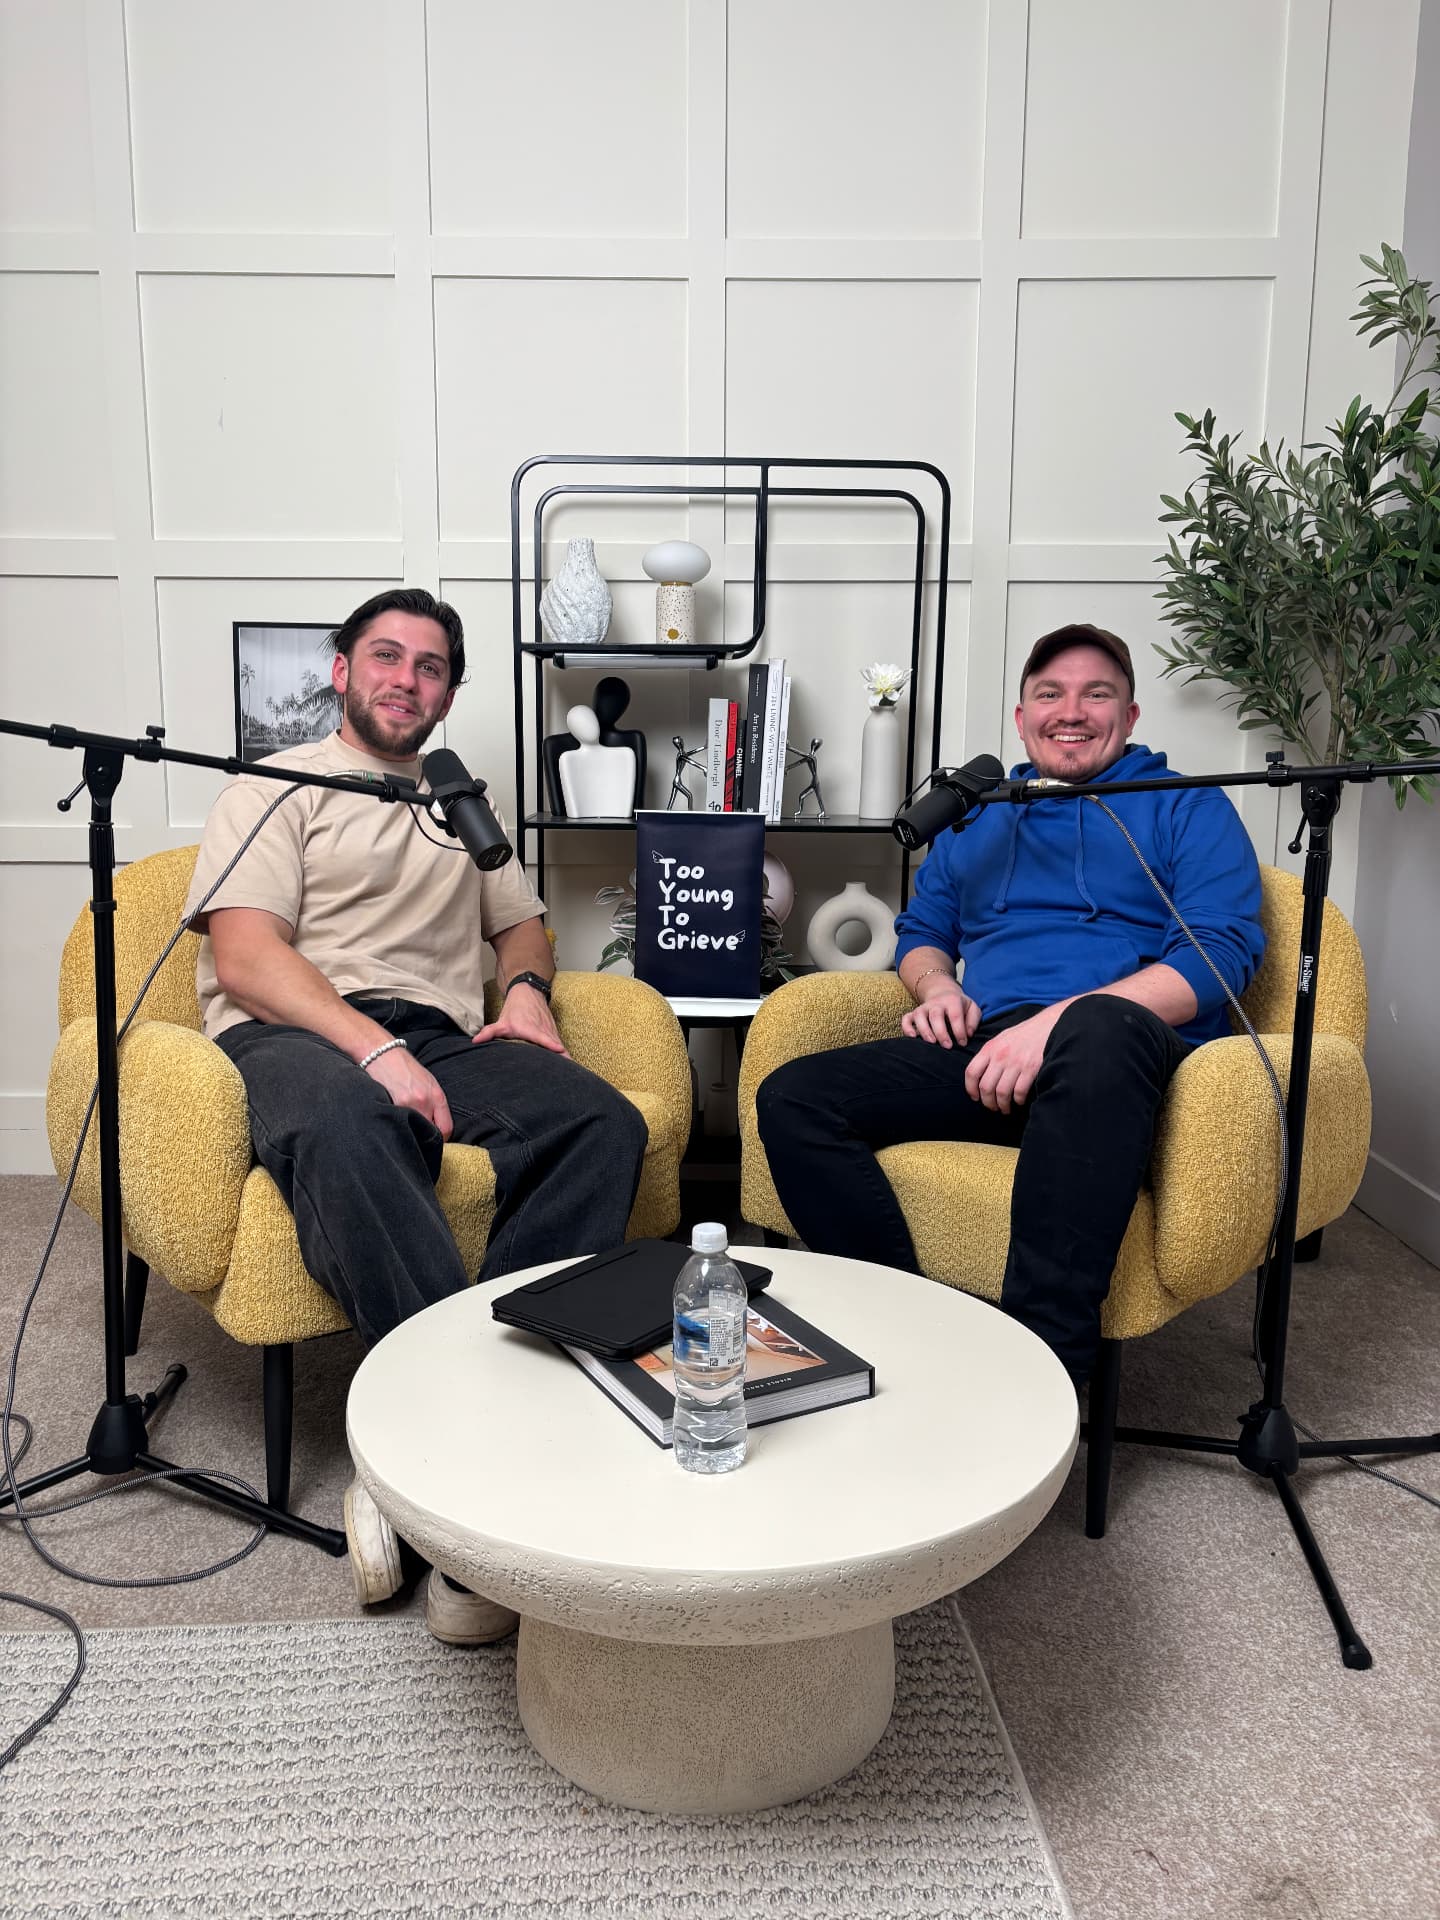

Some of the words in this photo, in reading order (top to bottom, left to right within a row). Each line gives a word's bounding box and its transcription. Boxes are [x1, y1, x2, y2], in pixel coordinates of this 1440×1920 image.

[714, 719, 723, 739] Dior
[752, 713, 760, 724] Art
[769, 708, 777, 732] LIVING
[735, 747, 744, 778] CHANEL
[659, 858, 705, 879] Too
[658, 879, 734, 911] Young
[658, 905, 690, 926] To
[657, 927, 739, 951] Grieve
